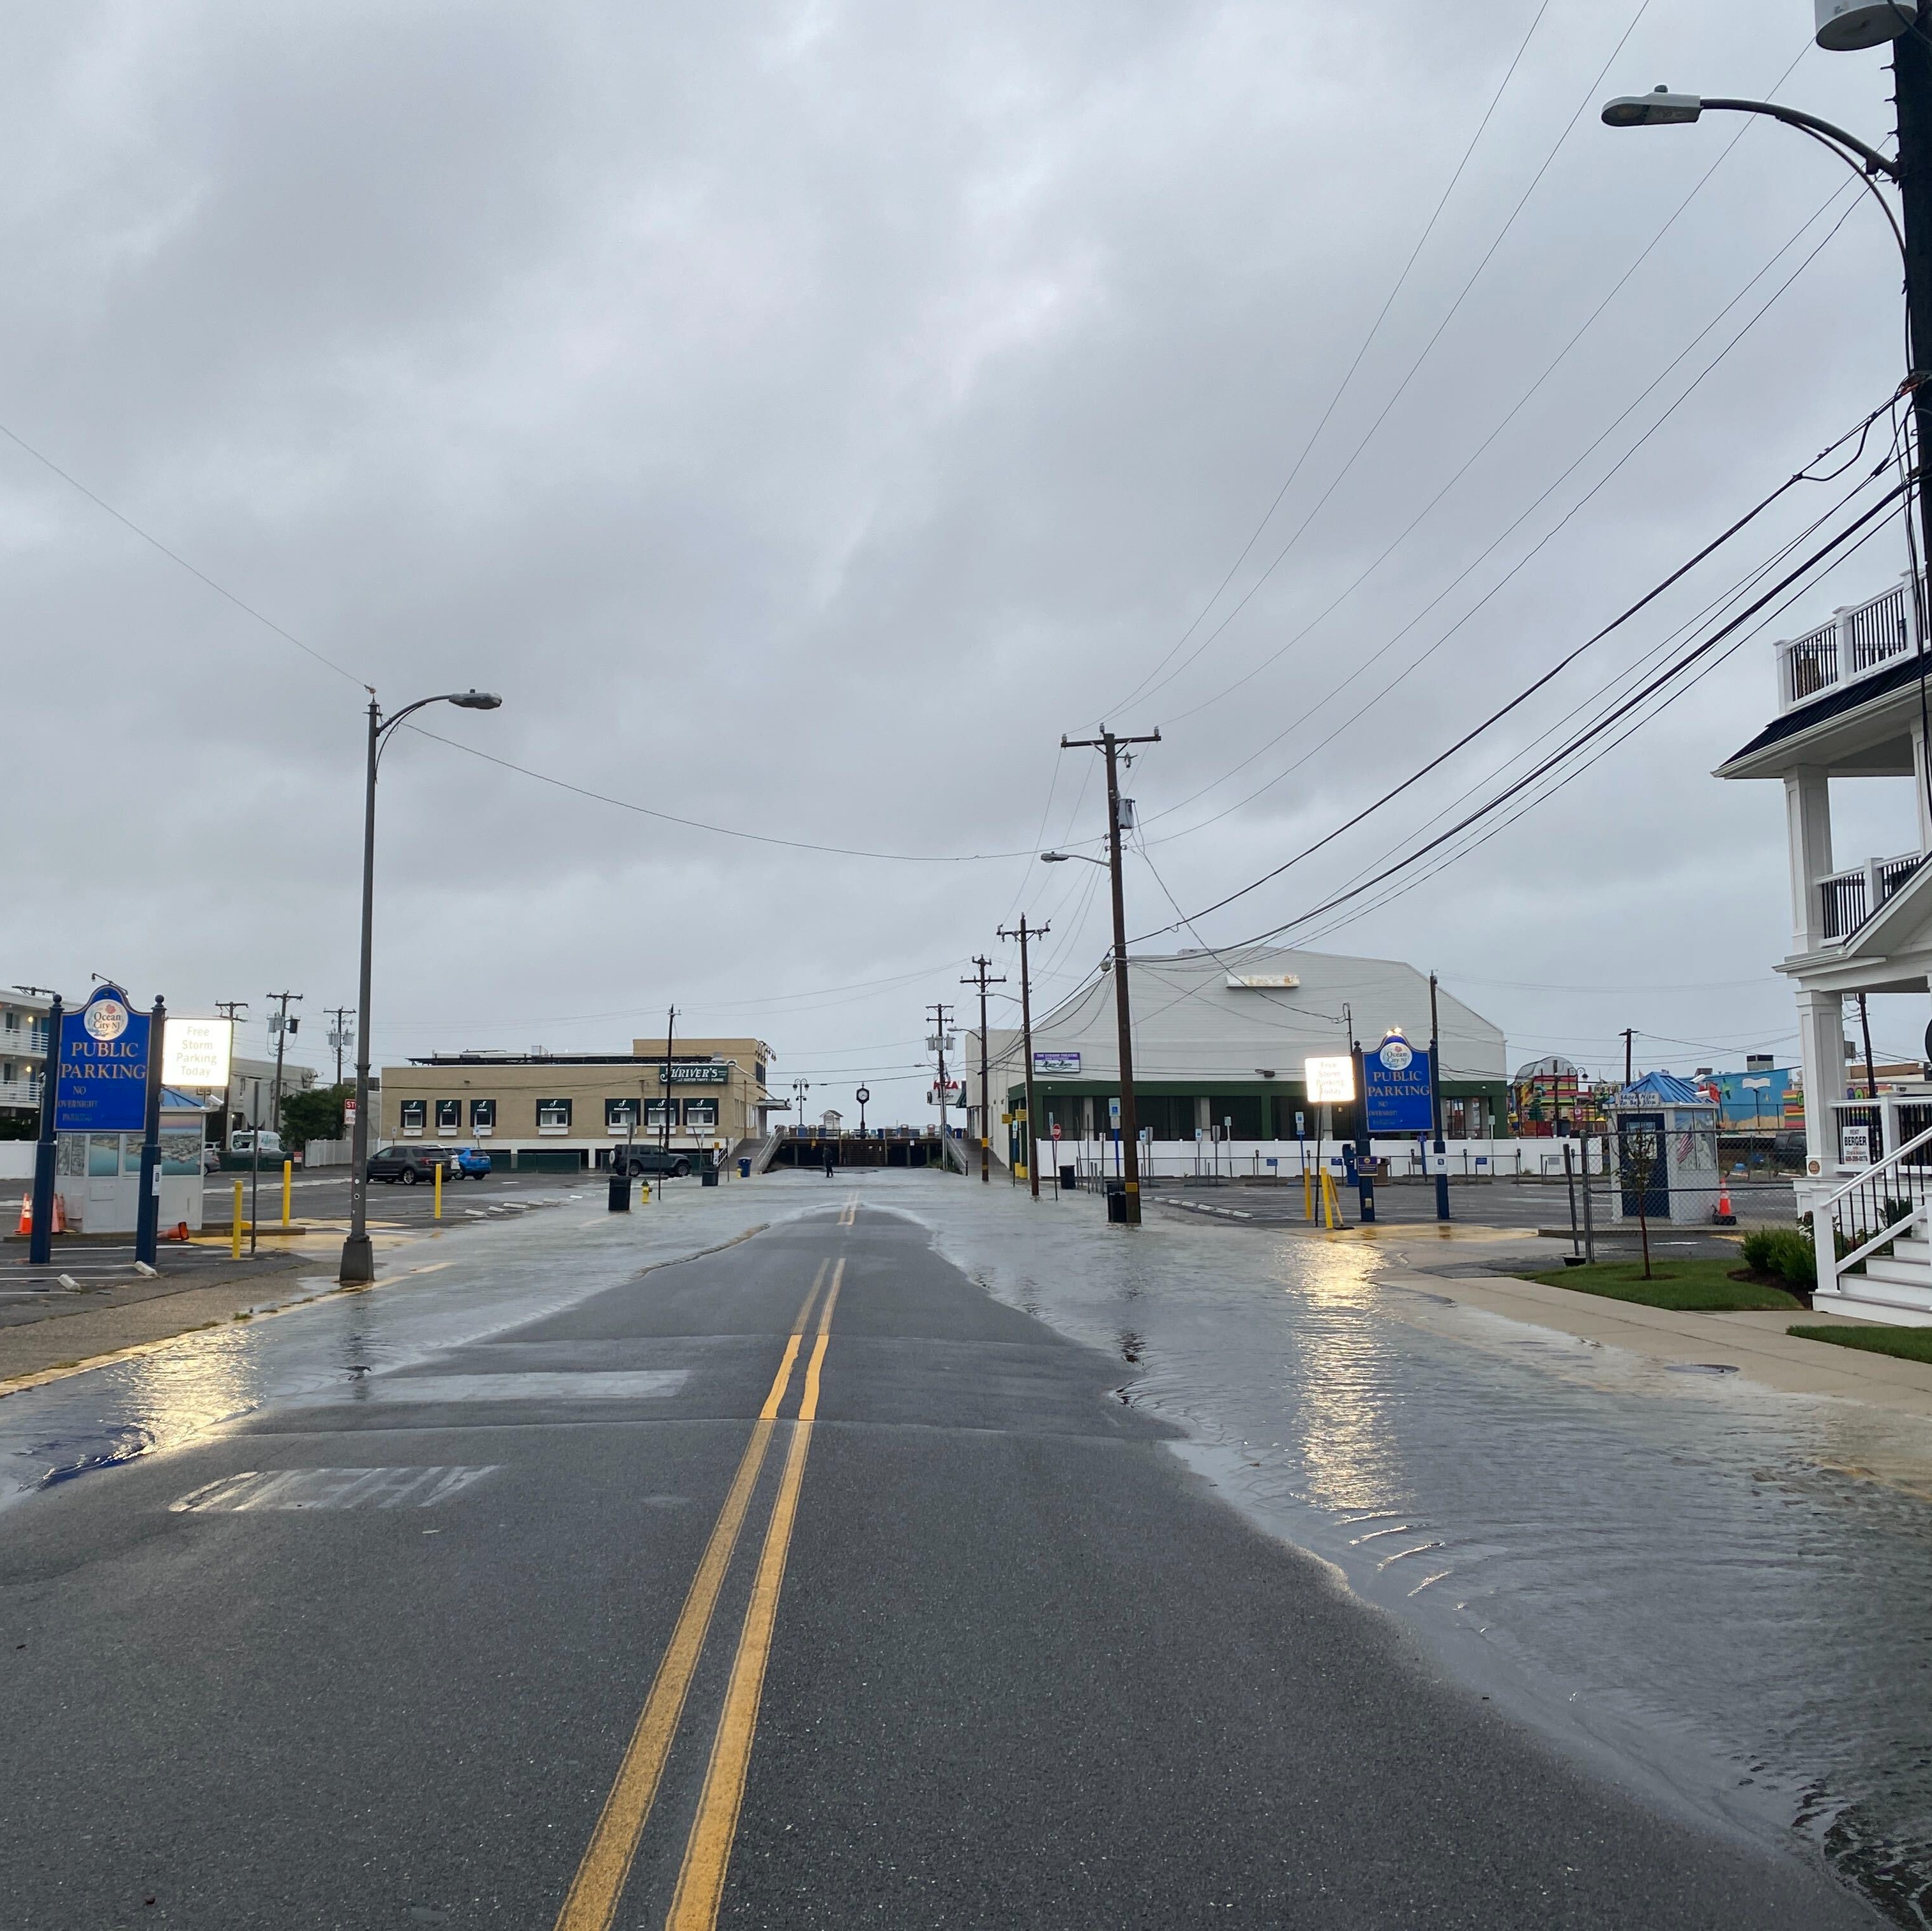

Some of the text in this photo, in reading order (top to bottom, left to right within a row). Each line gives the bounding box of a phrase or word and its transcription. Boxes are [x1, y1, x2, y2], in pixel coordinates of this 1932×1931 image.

[94, 1011, 121, 1021] Ocean
[93, 1021, 120, 1030] City NJ
[187, 1026, 209, 1036] Free
[72, 1042, 139, 1057] PUBLIC
[182, 1040, 213, 1050] Storm
[176, 1052, 217, 1065] Parking
[61, 1064, 146, 1079] PARKING
[181, 1066, 211, 1077] Today
[1373, 1071, 1422, 1082] PUBLIC
[73, 1086, 86, 1095] NO
[1367, 1086, 1430, 1096] PARKING
[1845, 1136, 1867, 1146] BERGER
